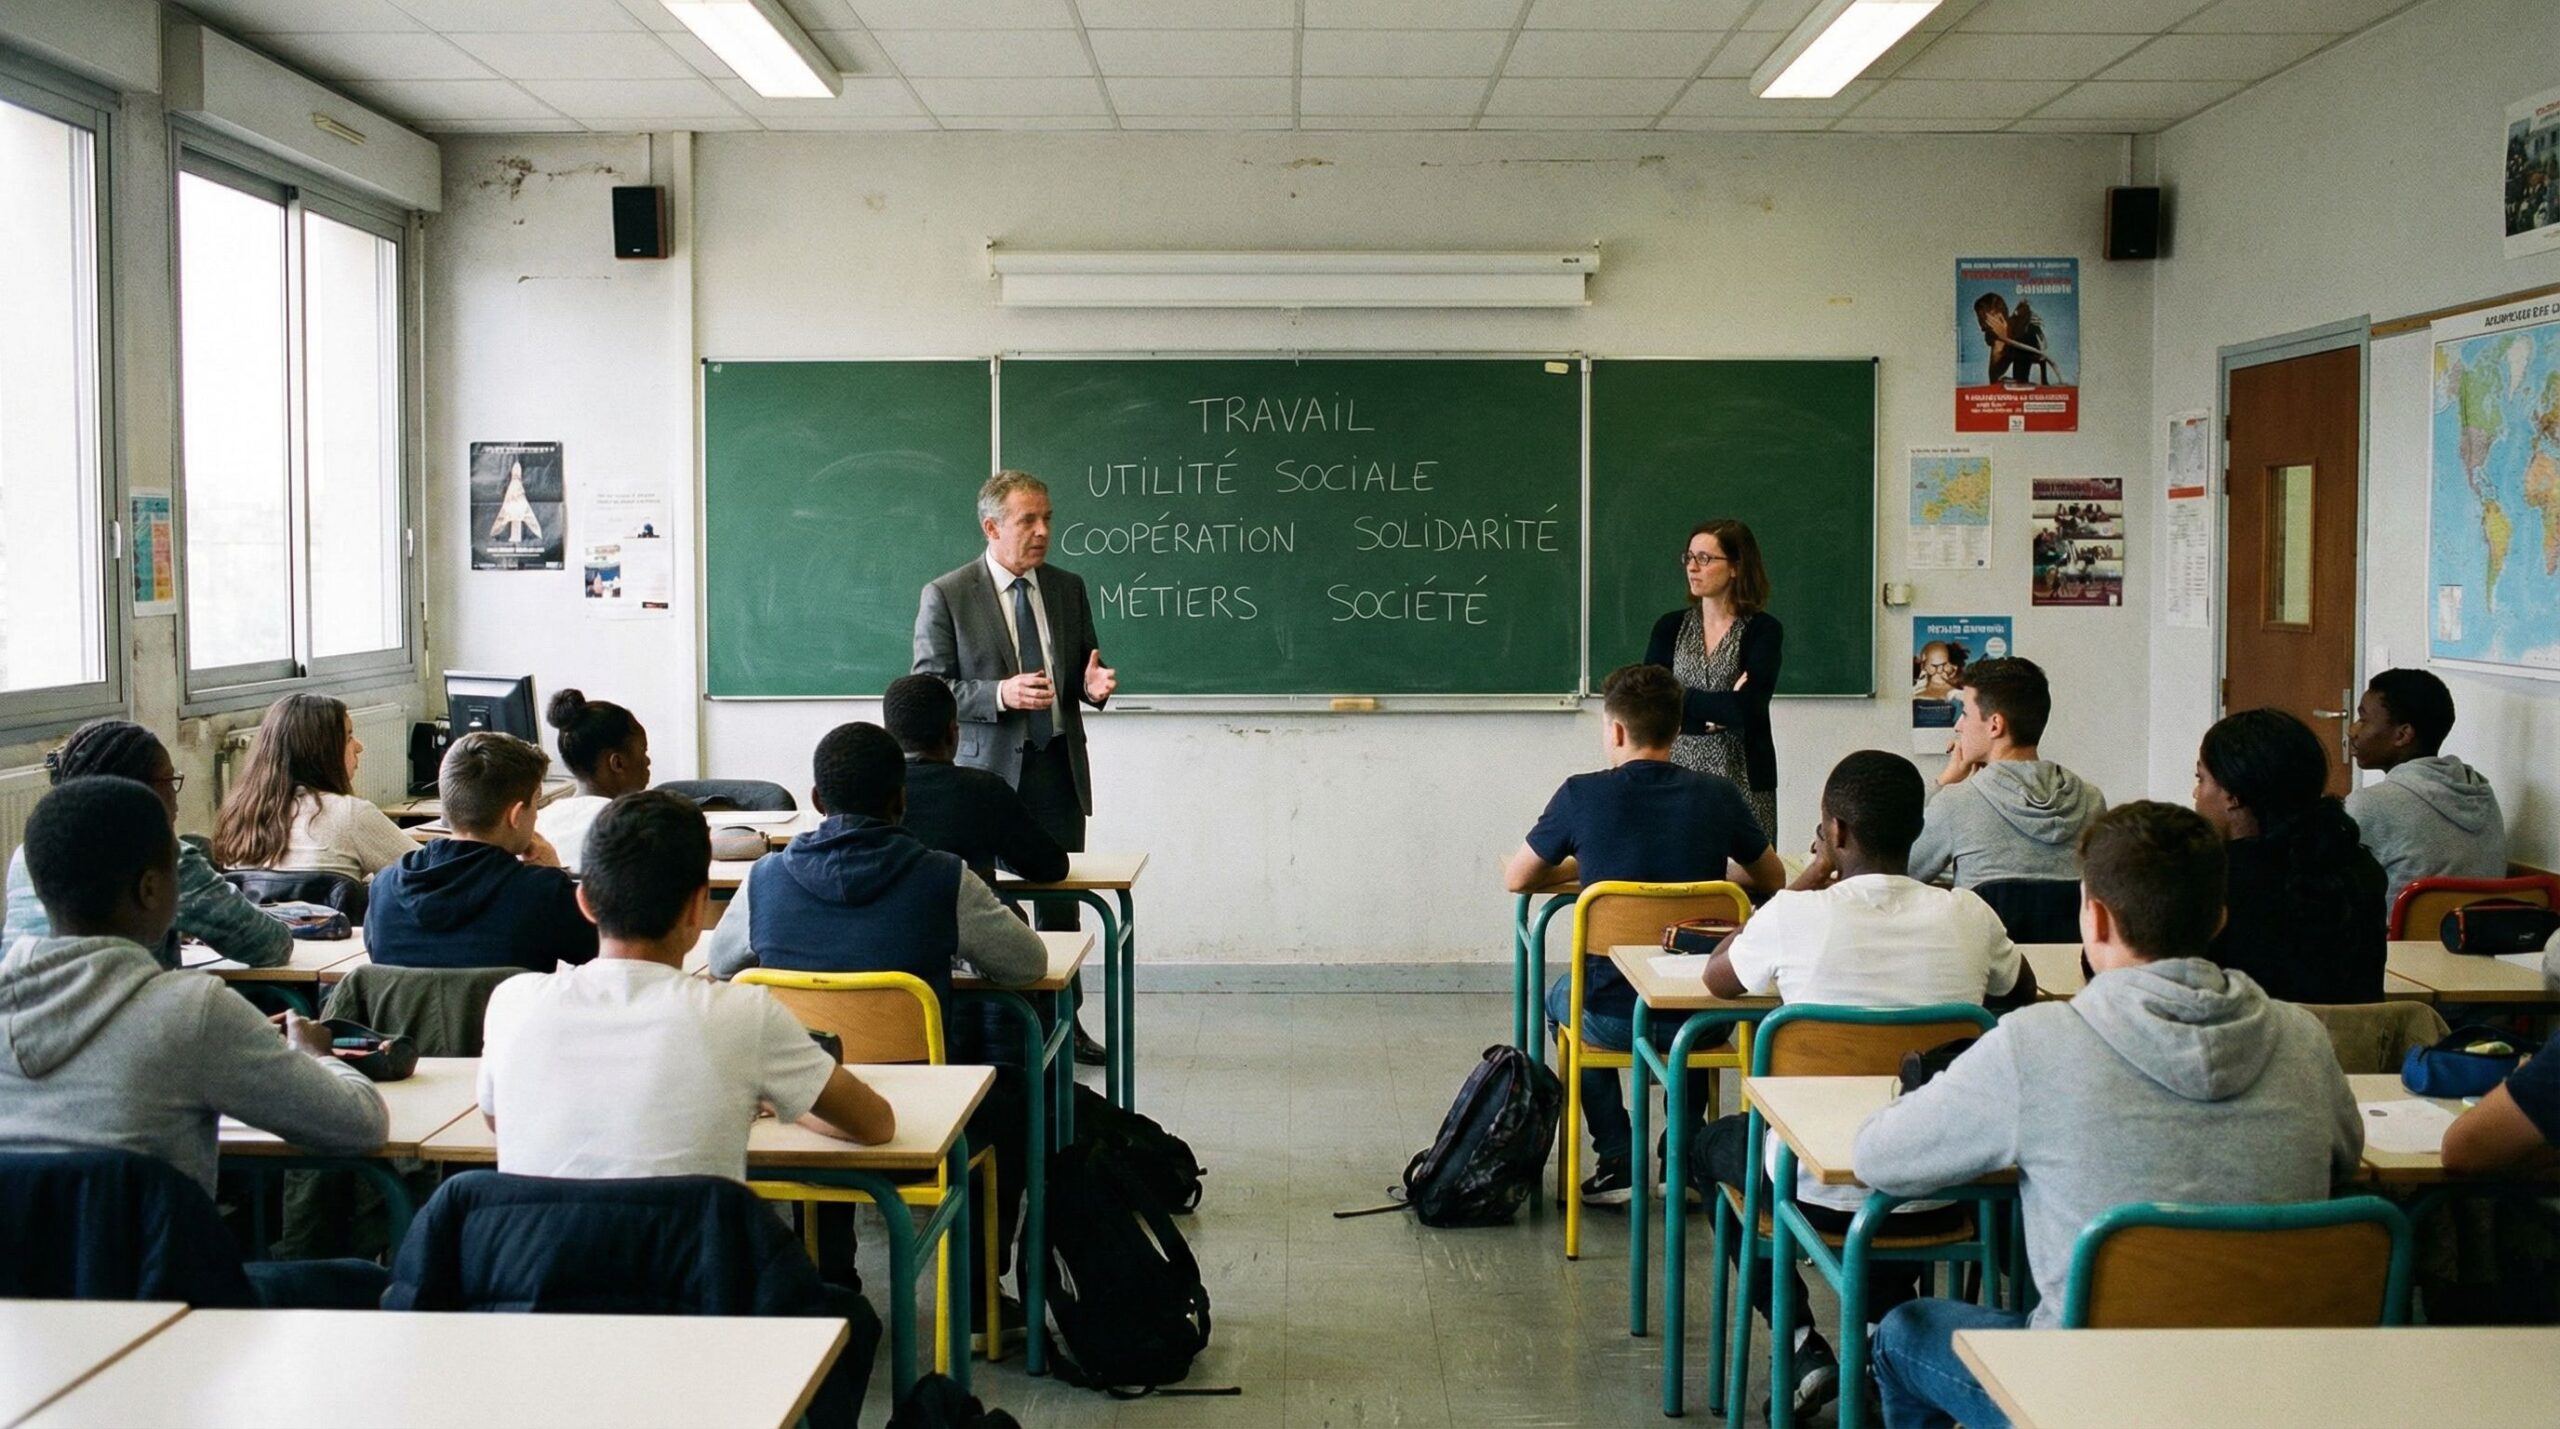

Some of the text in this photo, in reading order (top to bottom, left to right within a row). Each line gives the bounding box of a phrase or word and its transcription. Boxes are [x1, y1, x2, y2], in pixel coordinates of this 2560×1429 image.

[1188, 392, 1375, 433] TRAVAIL
[1088, 448, 1439, 498] UTILITÉ SOCIALE
[1061, 504, 1559, 556] COOPÉRATION SOLIDARITÉ
[1100, 572, 1488, 624] MÉTIERS SOCIÉTÉ
